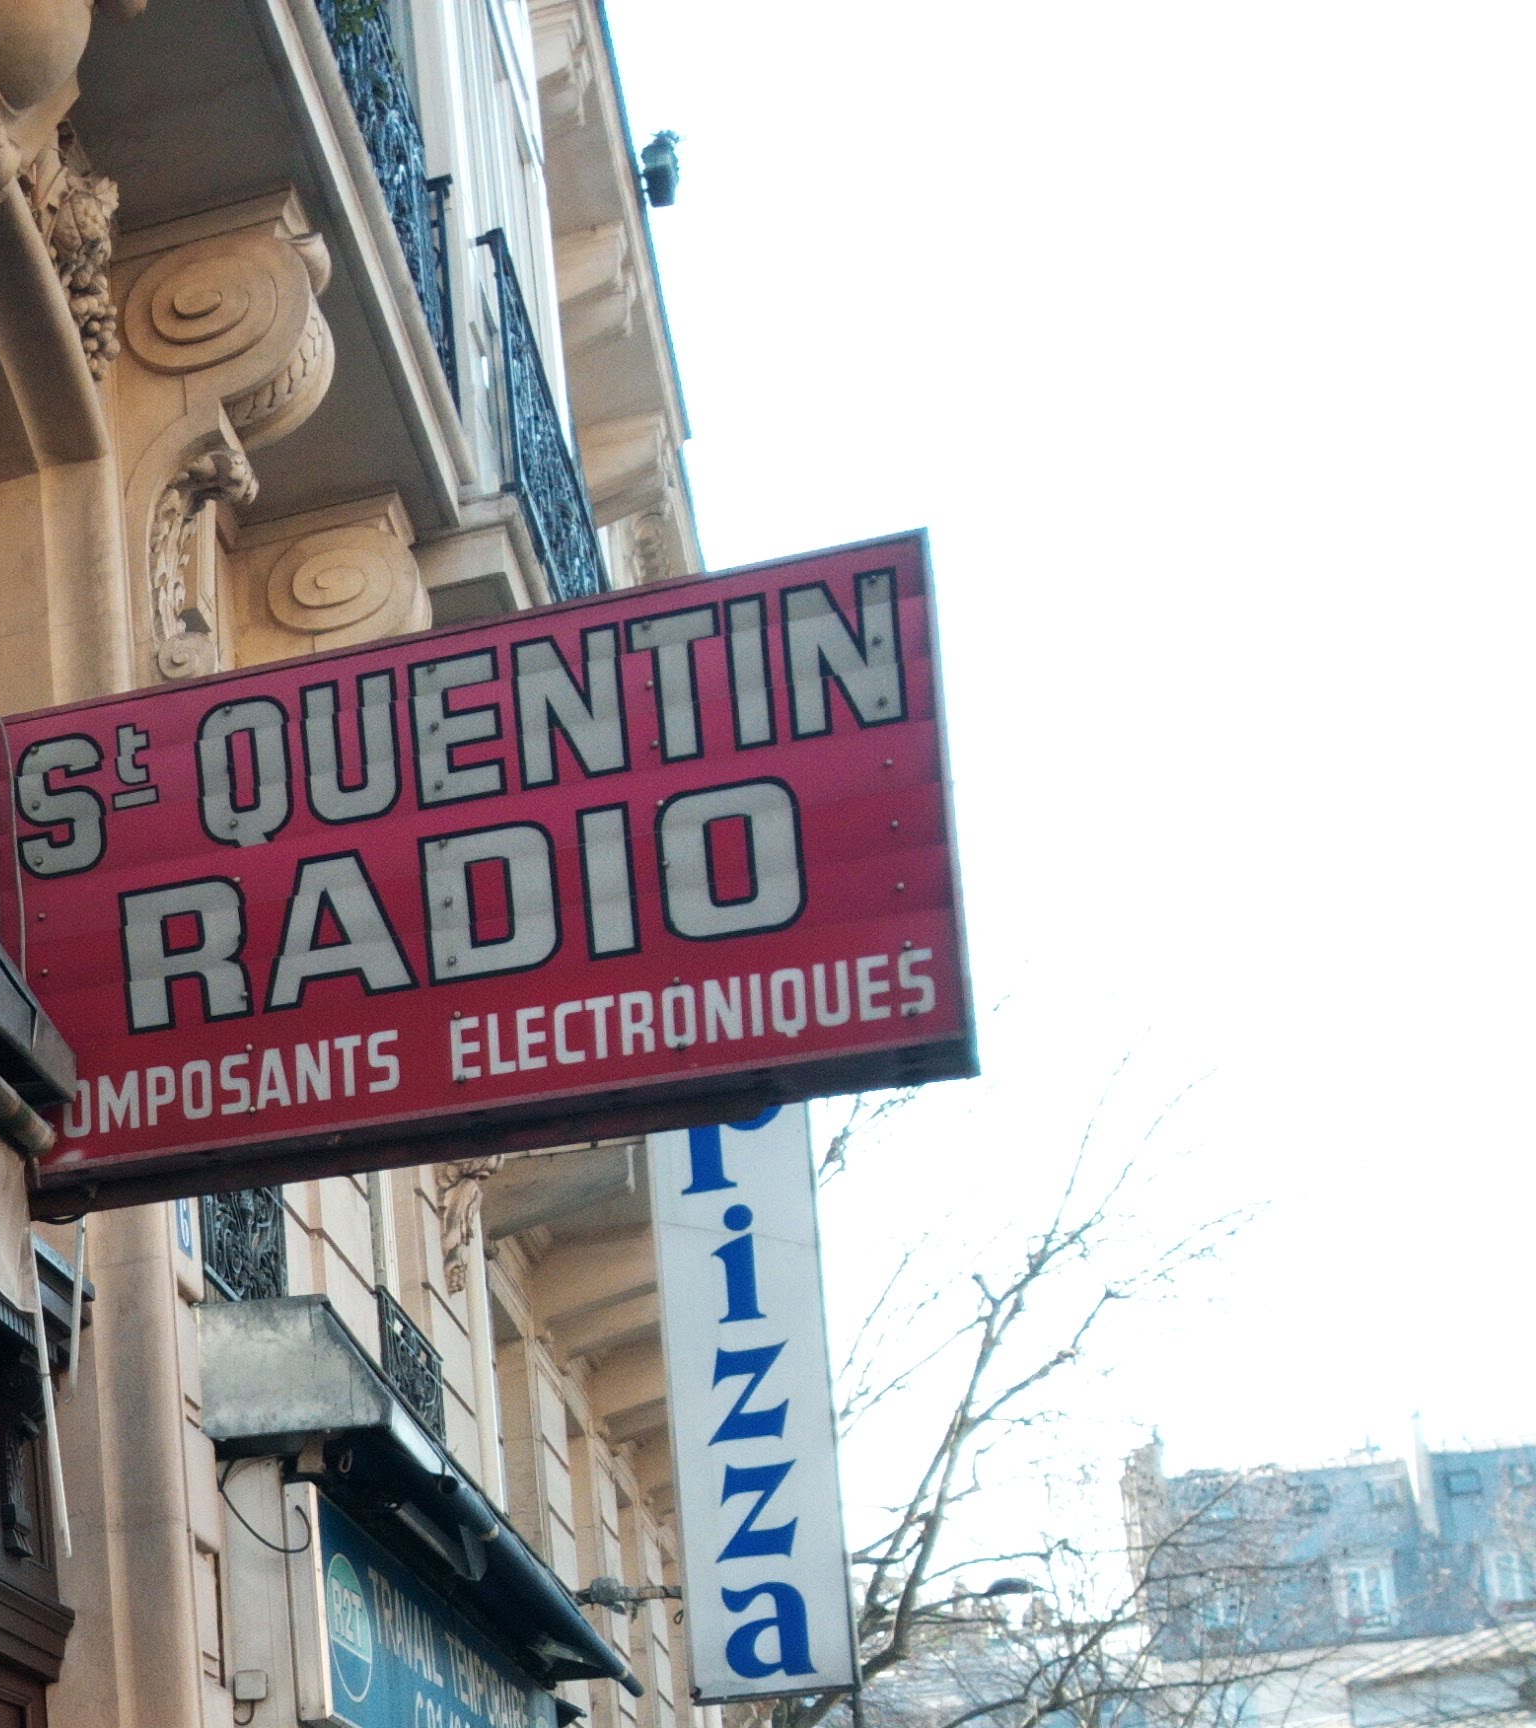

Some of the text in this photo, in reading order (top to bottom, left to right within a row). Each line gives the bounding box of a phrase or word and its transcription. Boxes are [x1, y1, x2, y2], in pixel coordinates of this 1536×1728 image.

[194, 566, 908, 849] QUENTIN
[119, 776, 805, 1034] RADIO
[63, 948, 936, 1142] OMPOSANTS ELECTRONIQUES
[368, 1565, 444, 1688] TRAVAIL
